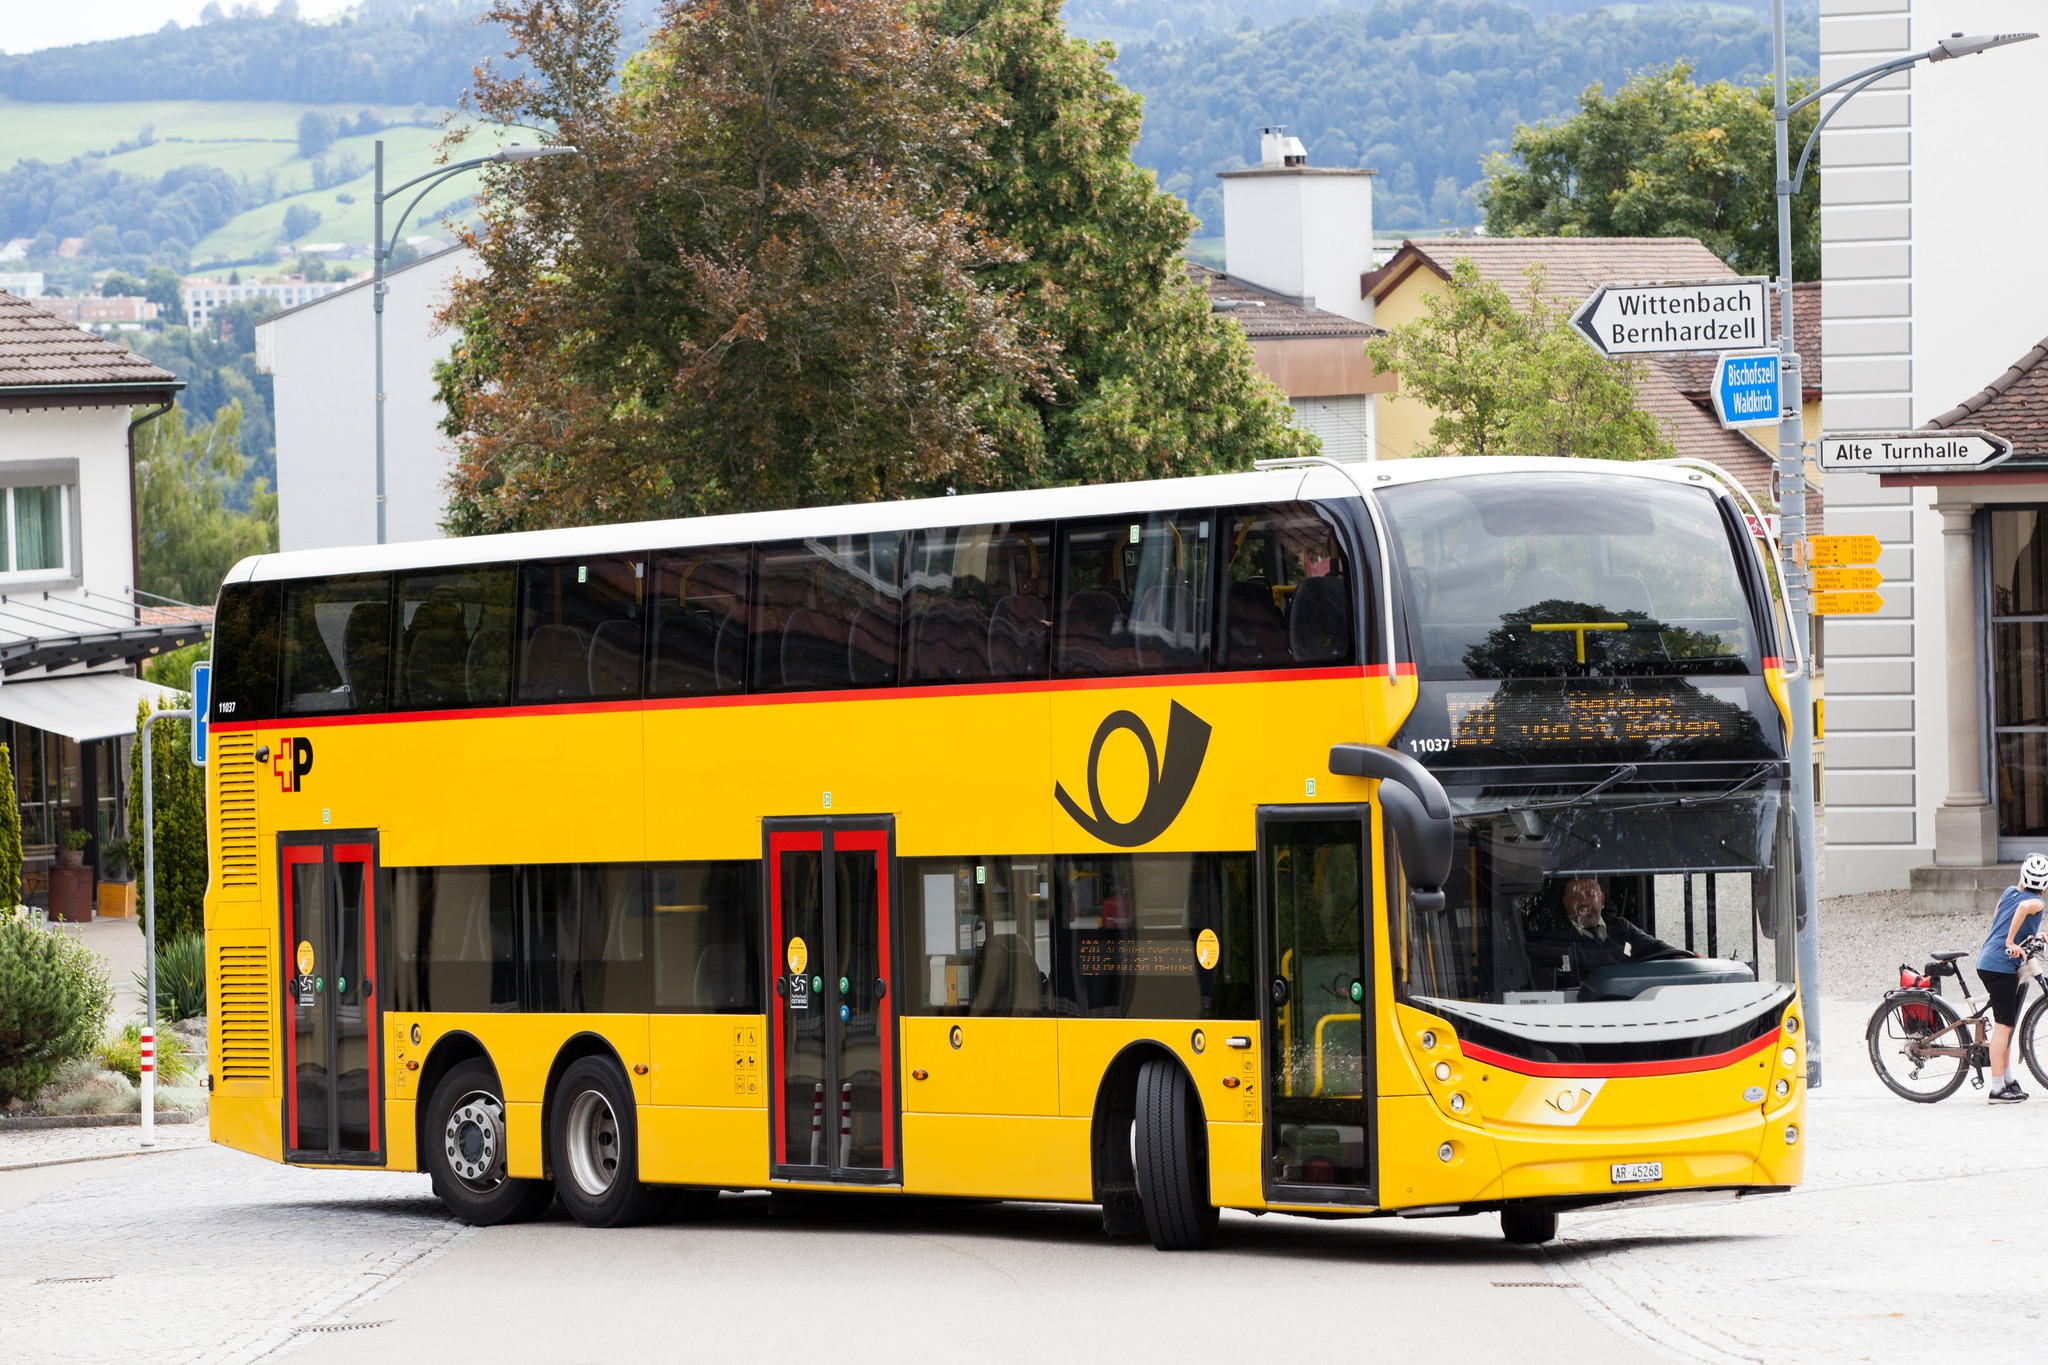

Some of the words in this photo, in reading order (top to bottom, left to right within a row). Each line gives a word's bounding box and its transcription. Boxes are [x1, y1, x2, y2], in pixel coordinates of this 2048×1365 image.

[1618, 290, 1751, 316] Wittenbach
[1612, 317, 1755, 344] Bernhardzell
[1728, 360, 1775, 386] Bischofszell
[1733, 388, 1772, 414] Waldkirch
[1836, 444, 1873, 460] Alte
[1881, 441, 1969, 459] Turnhalle
[219, 702, 236, 713] 11037
[1410, 738, 1450, 752] 11037
